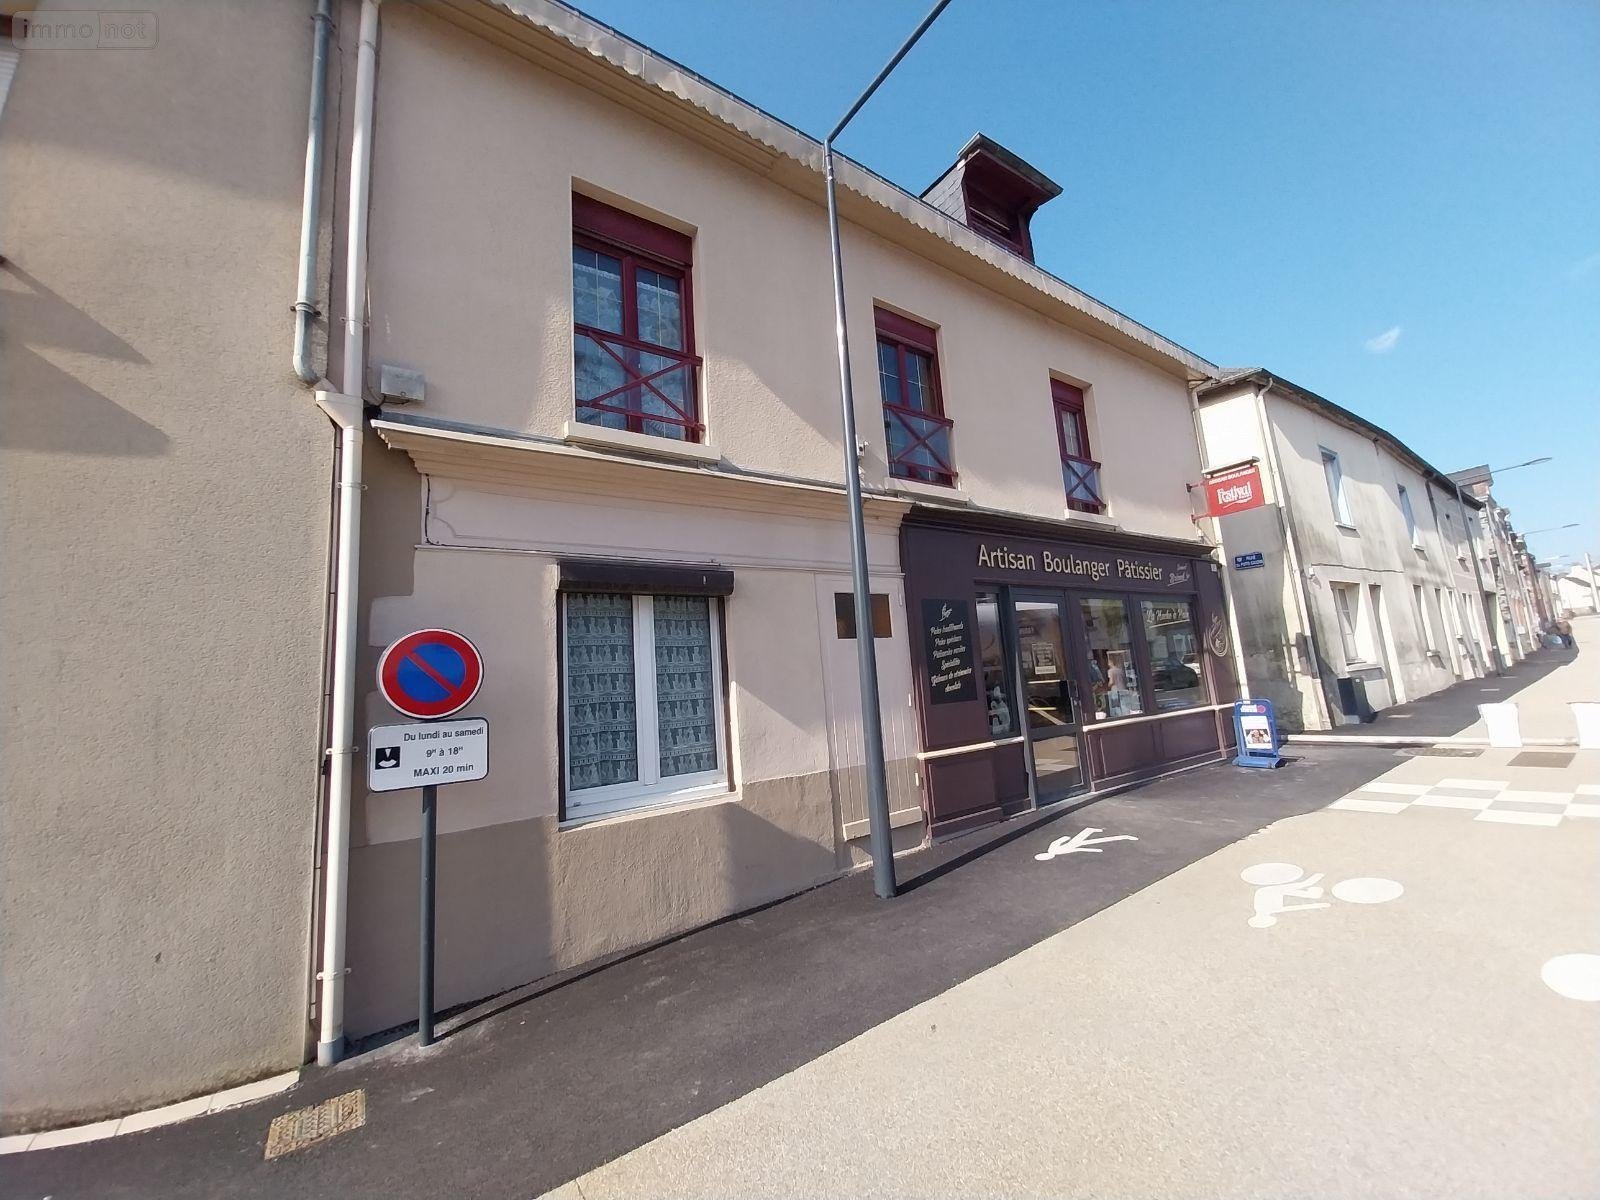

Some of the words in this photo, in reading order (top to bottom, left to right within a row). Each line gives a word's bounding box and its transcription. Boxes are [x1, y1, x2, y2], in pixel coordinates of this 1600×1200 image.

[1216, 481, 1252, 505] Festival
[978, 544, 1036, 571] Artisan
[1043, 550, 1110, 580] Boulanger
[1117, 559, 1163, 581] Pâtissier
[403, 732, 416, 742] Du
[418, 731, 440, 740] lundi
[442, 730, 453, 738] au
[454, 726, 484, 738] samedi
[439, 747, 445, 757] à
[413, 766, 440, 778] MAXI
[442, 765, 454, 775] 20
[456, 763, 474, 772] min
